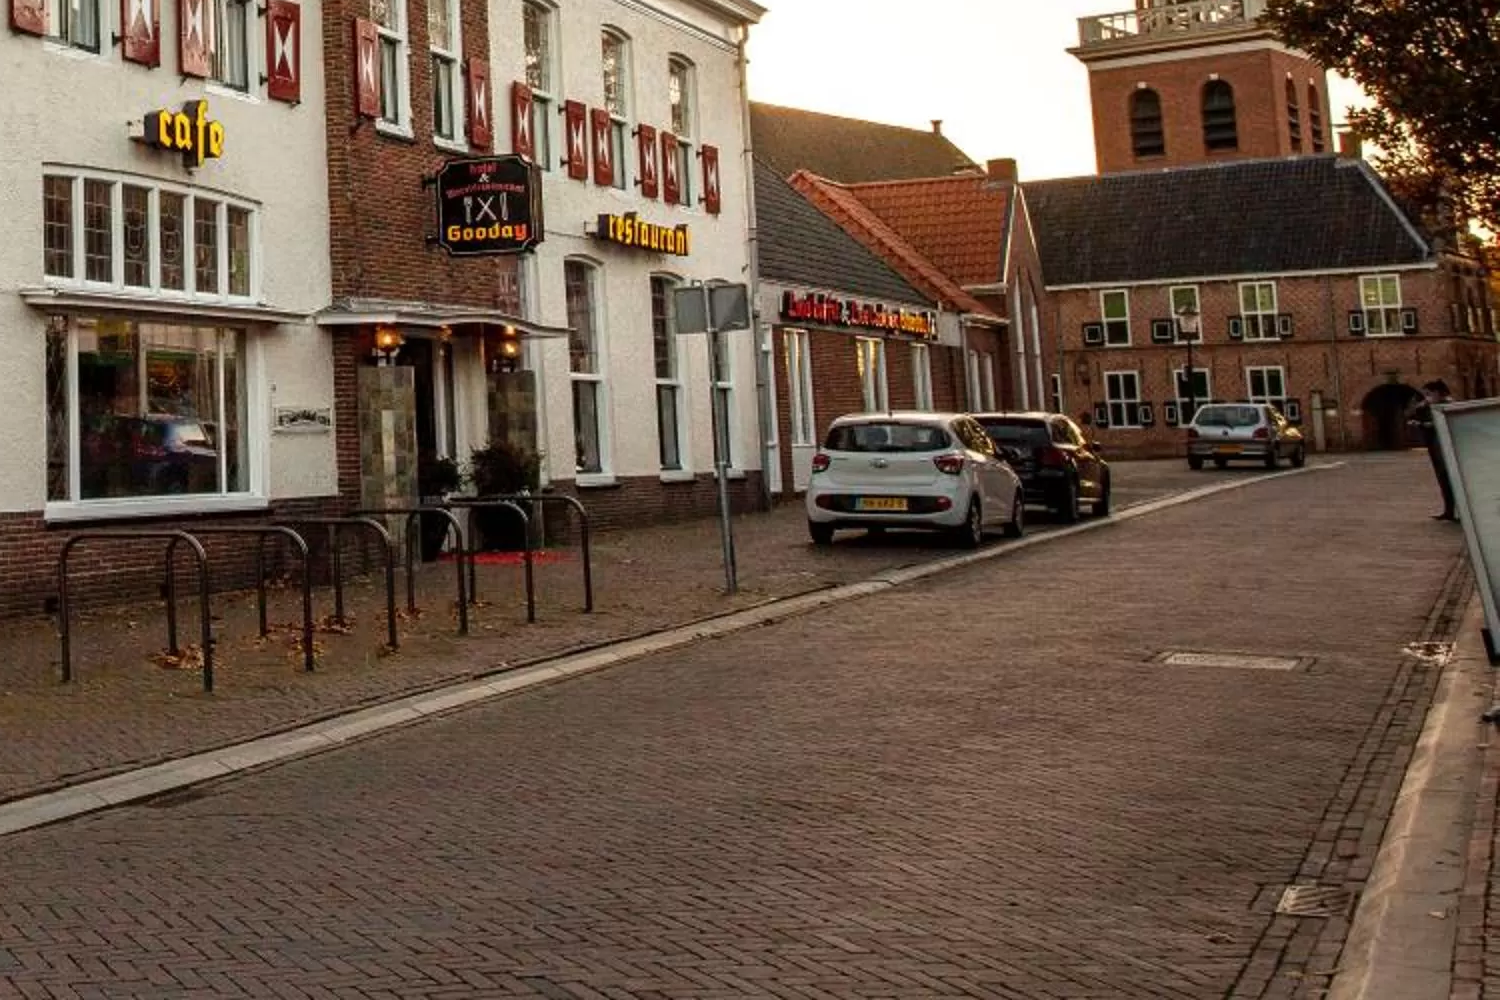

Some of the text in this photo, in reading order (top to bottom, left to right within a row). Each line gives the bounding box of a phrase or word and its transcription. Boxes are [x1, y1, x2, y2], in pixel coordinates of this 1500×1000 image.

[159, 98, 225, 168] cafe
[447, 221, 527, 242] Gooday
[609, 214, 693, 256] restaurant
